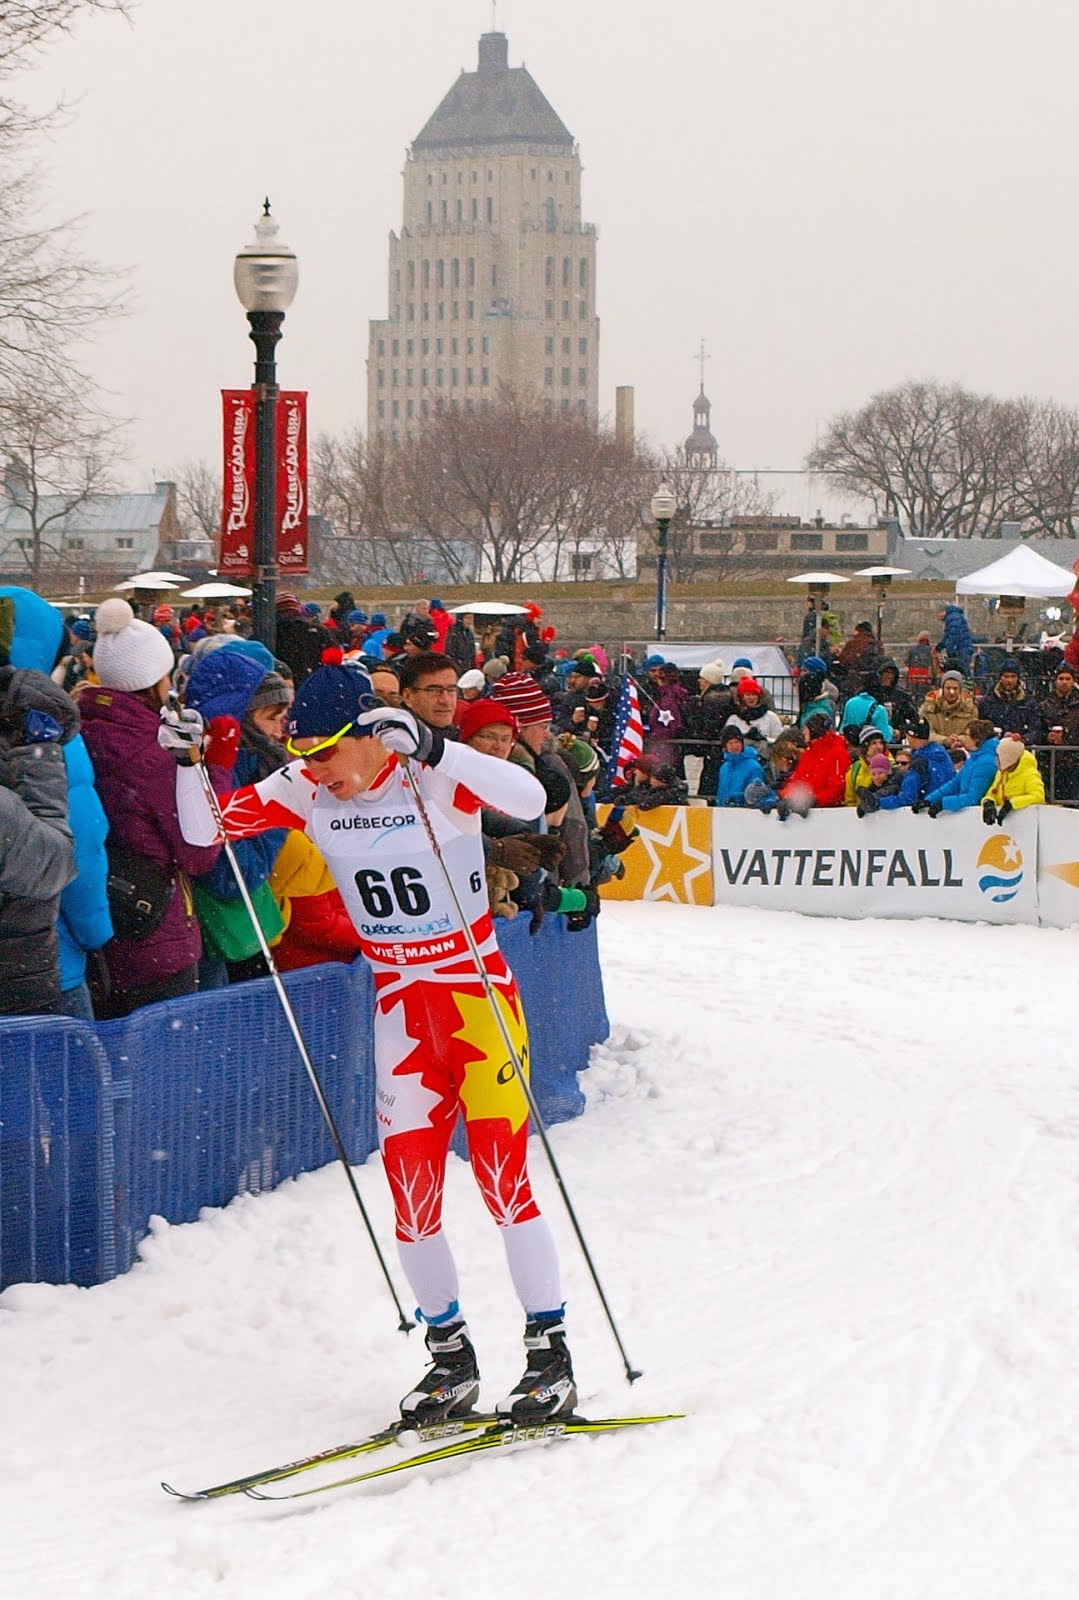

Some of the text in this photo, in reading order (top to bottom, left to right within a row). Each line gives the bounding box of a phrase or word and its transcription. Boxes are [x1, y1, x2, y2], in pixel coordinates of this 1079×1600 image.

[330, 814, 416, 830] QUÉBECOR
[720, 847, 963, 887] VATTENFALL
[354, 866, 431, 919] 66
[371, 939, 455, 965] VIESSMANN
[418, 1421, 465, 1442] SCHER
[500, 1424, 567, 1446] FISCHER
